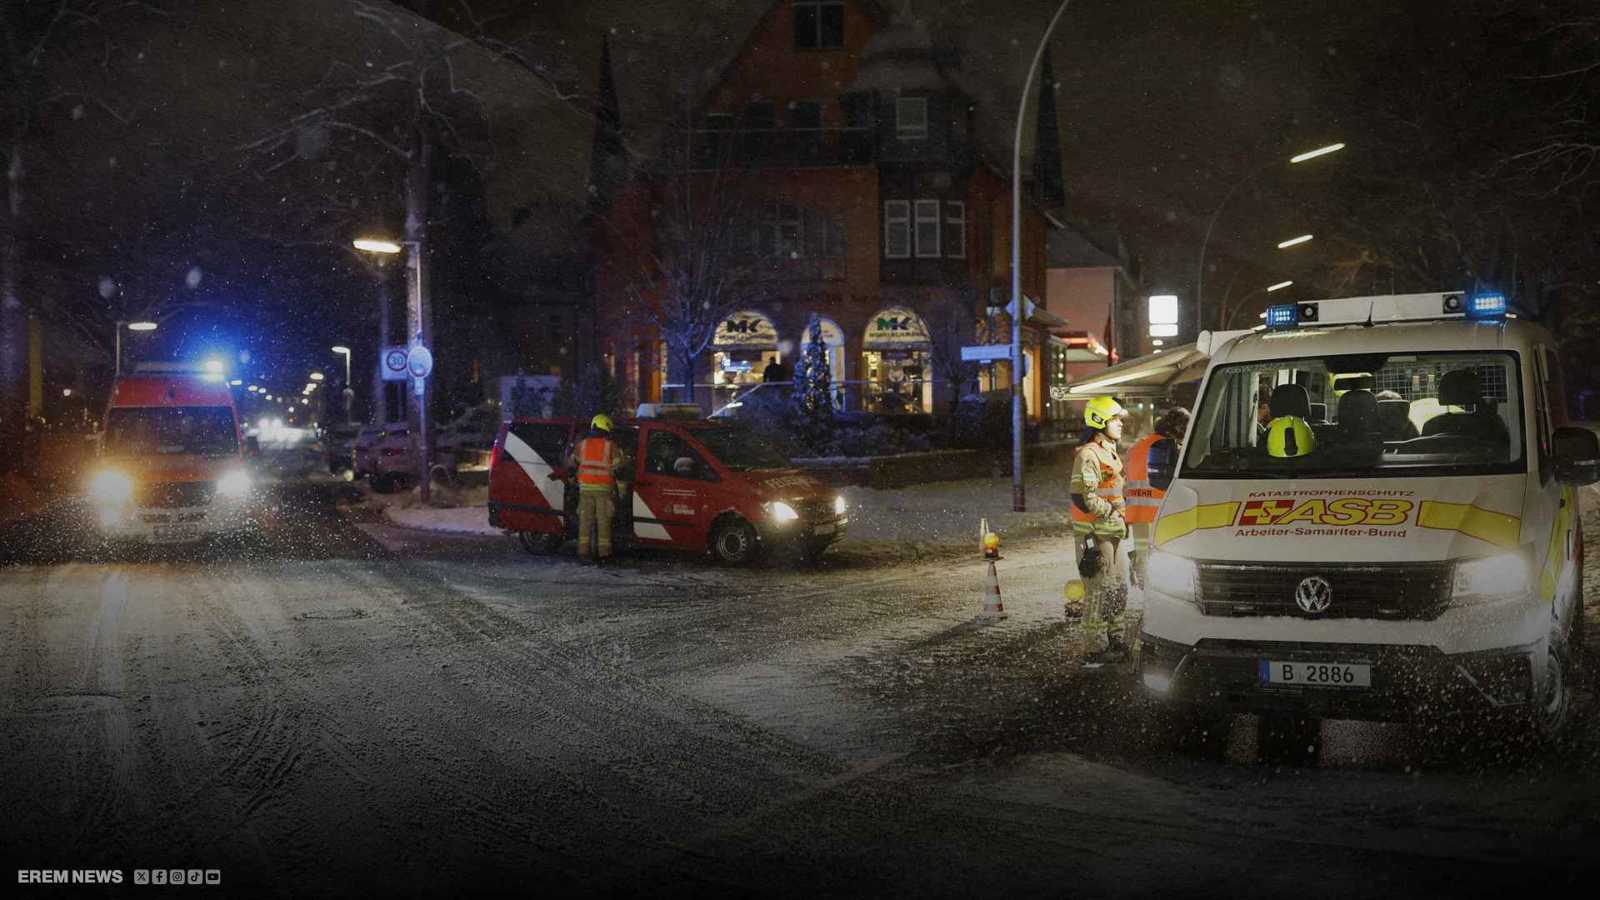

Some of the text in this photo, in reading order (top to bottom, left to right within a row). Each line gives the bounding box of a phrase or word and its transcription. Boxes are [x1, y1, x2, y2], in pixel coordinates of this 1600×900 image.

[725, 319, 761, 333] MK
[877, 316, 910, 331] MK
[1249, 489, 1415, 498] KATASTROPHENSCHUTZ
[1276, 498, 1414, 526] ASB
[1235, 527, 1407, 539] Arbeiter-Samariter-Bund
[1282, 664, 1354, 683] B 2886
